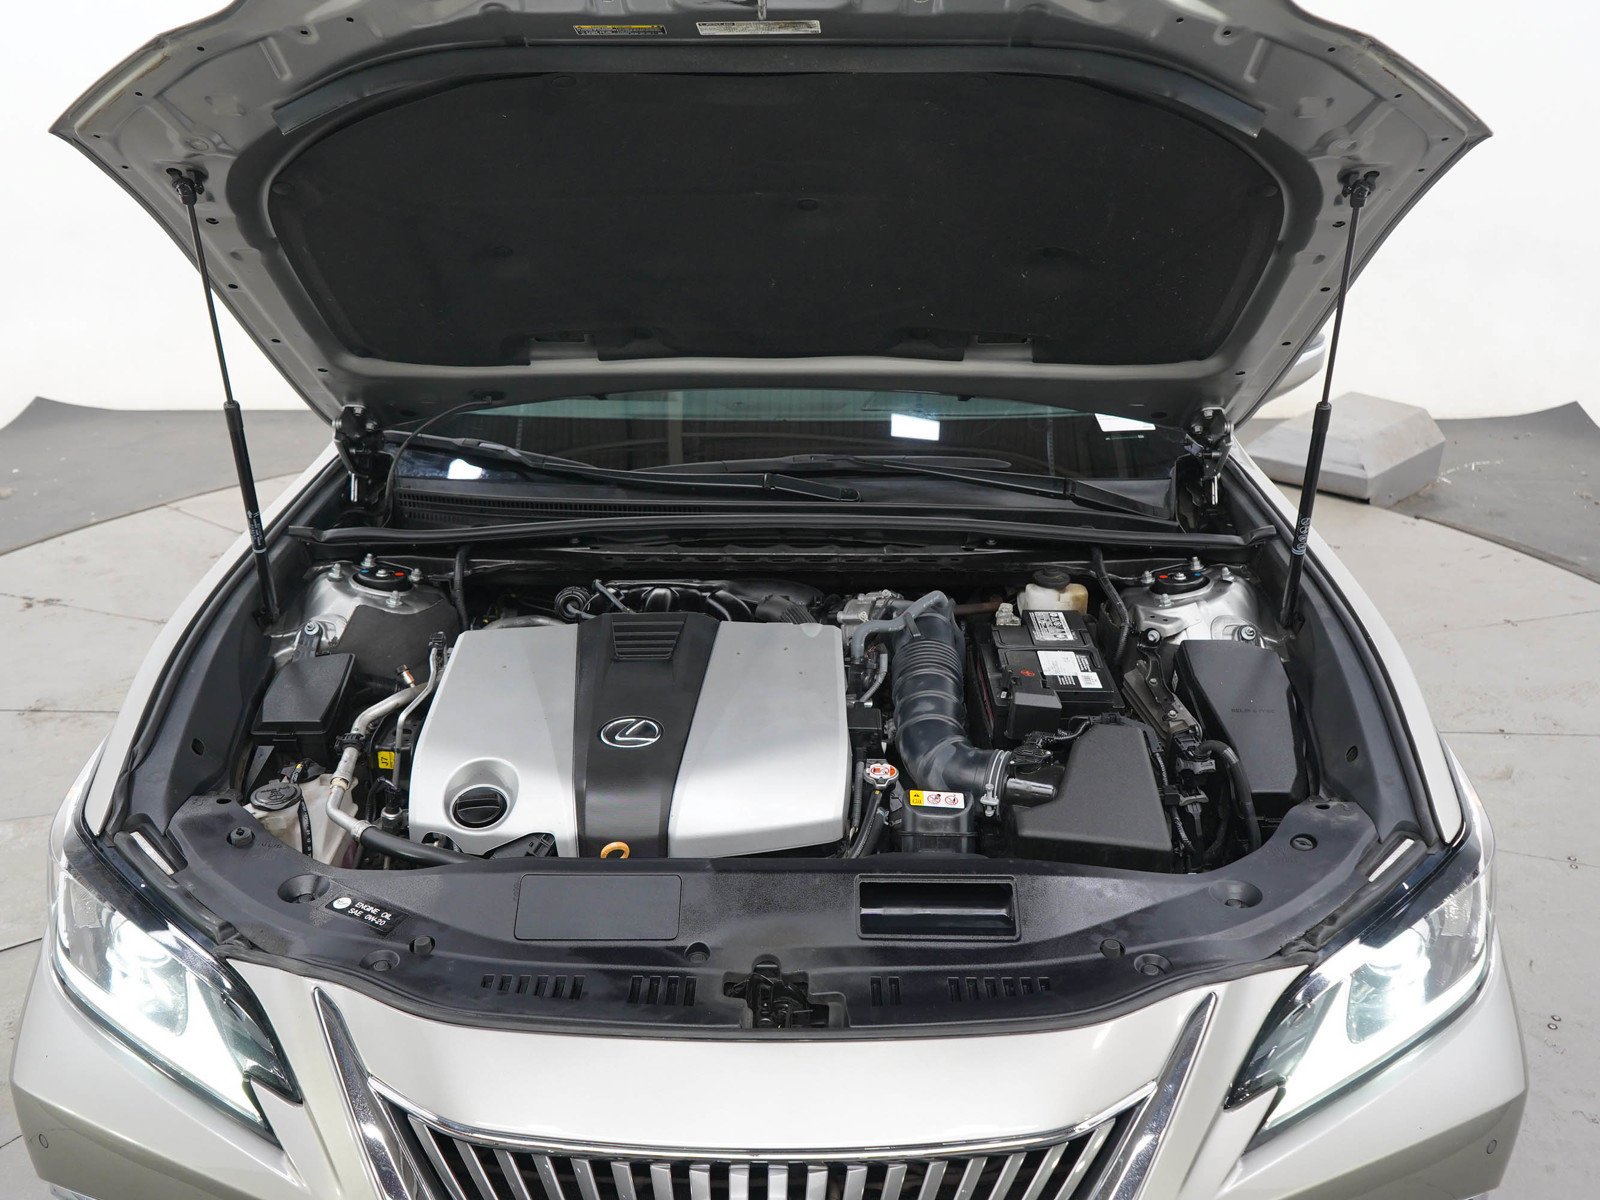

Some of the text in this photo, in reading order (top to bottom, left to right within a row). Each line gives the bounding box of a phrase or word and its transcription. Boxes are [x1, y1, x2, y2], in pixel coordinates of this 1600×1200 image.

[348, 908, 364, 917] SAE
[355, 902, 392, 920] ENGINE OIL
